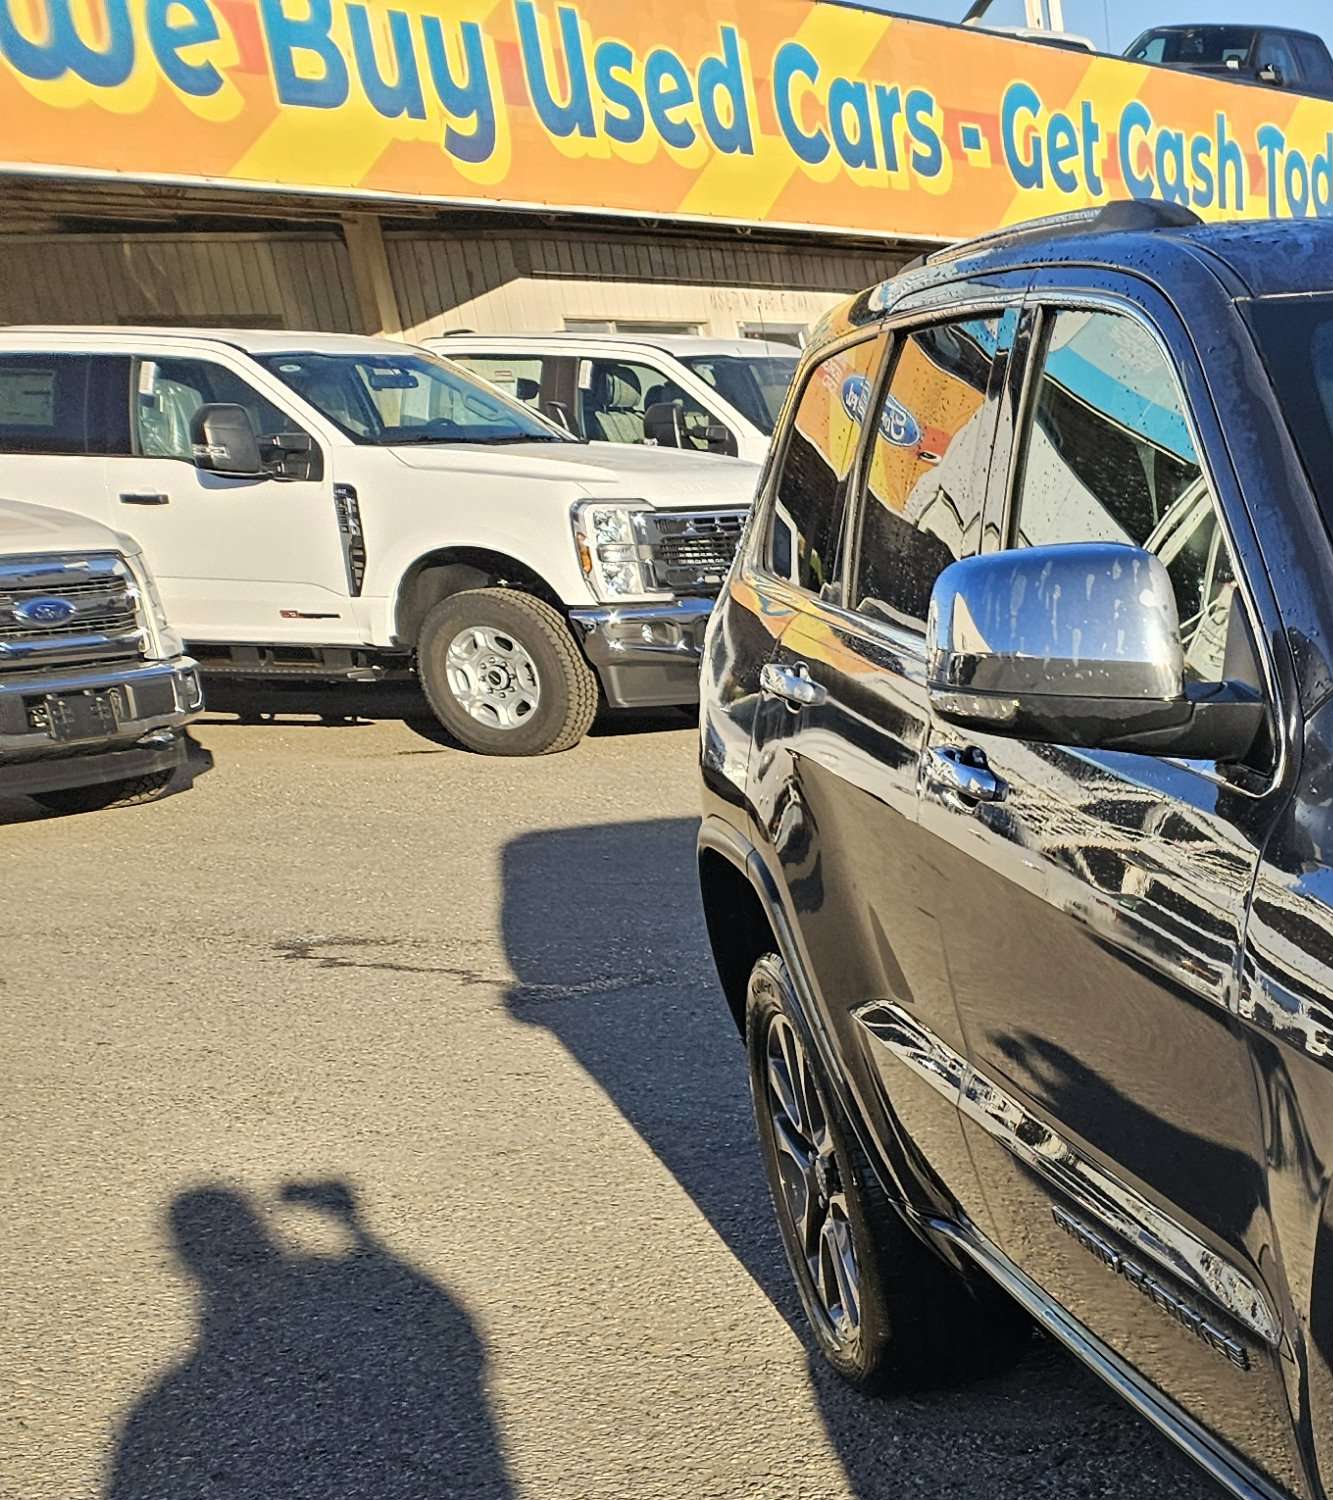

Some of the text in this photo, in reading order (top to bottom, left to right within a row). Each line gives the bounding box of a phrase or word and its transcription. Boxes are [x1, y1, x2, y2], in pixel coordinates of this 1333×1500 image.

[0, 0, 225, 97] We
[260, 0, 496, 163] Buy
[514, 0, 755, 156] Used
[772, 42, 944, 178] Cars
[1001, 83, 1104, 197] Get
[1118, 99, 1245, 212] Cash
